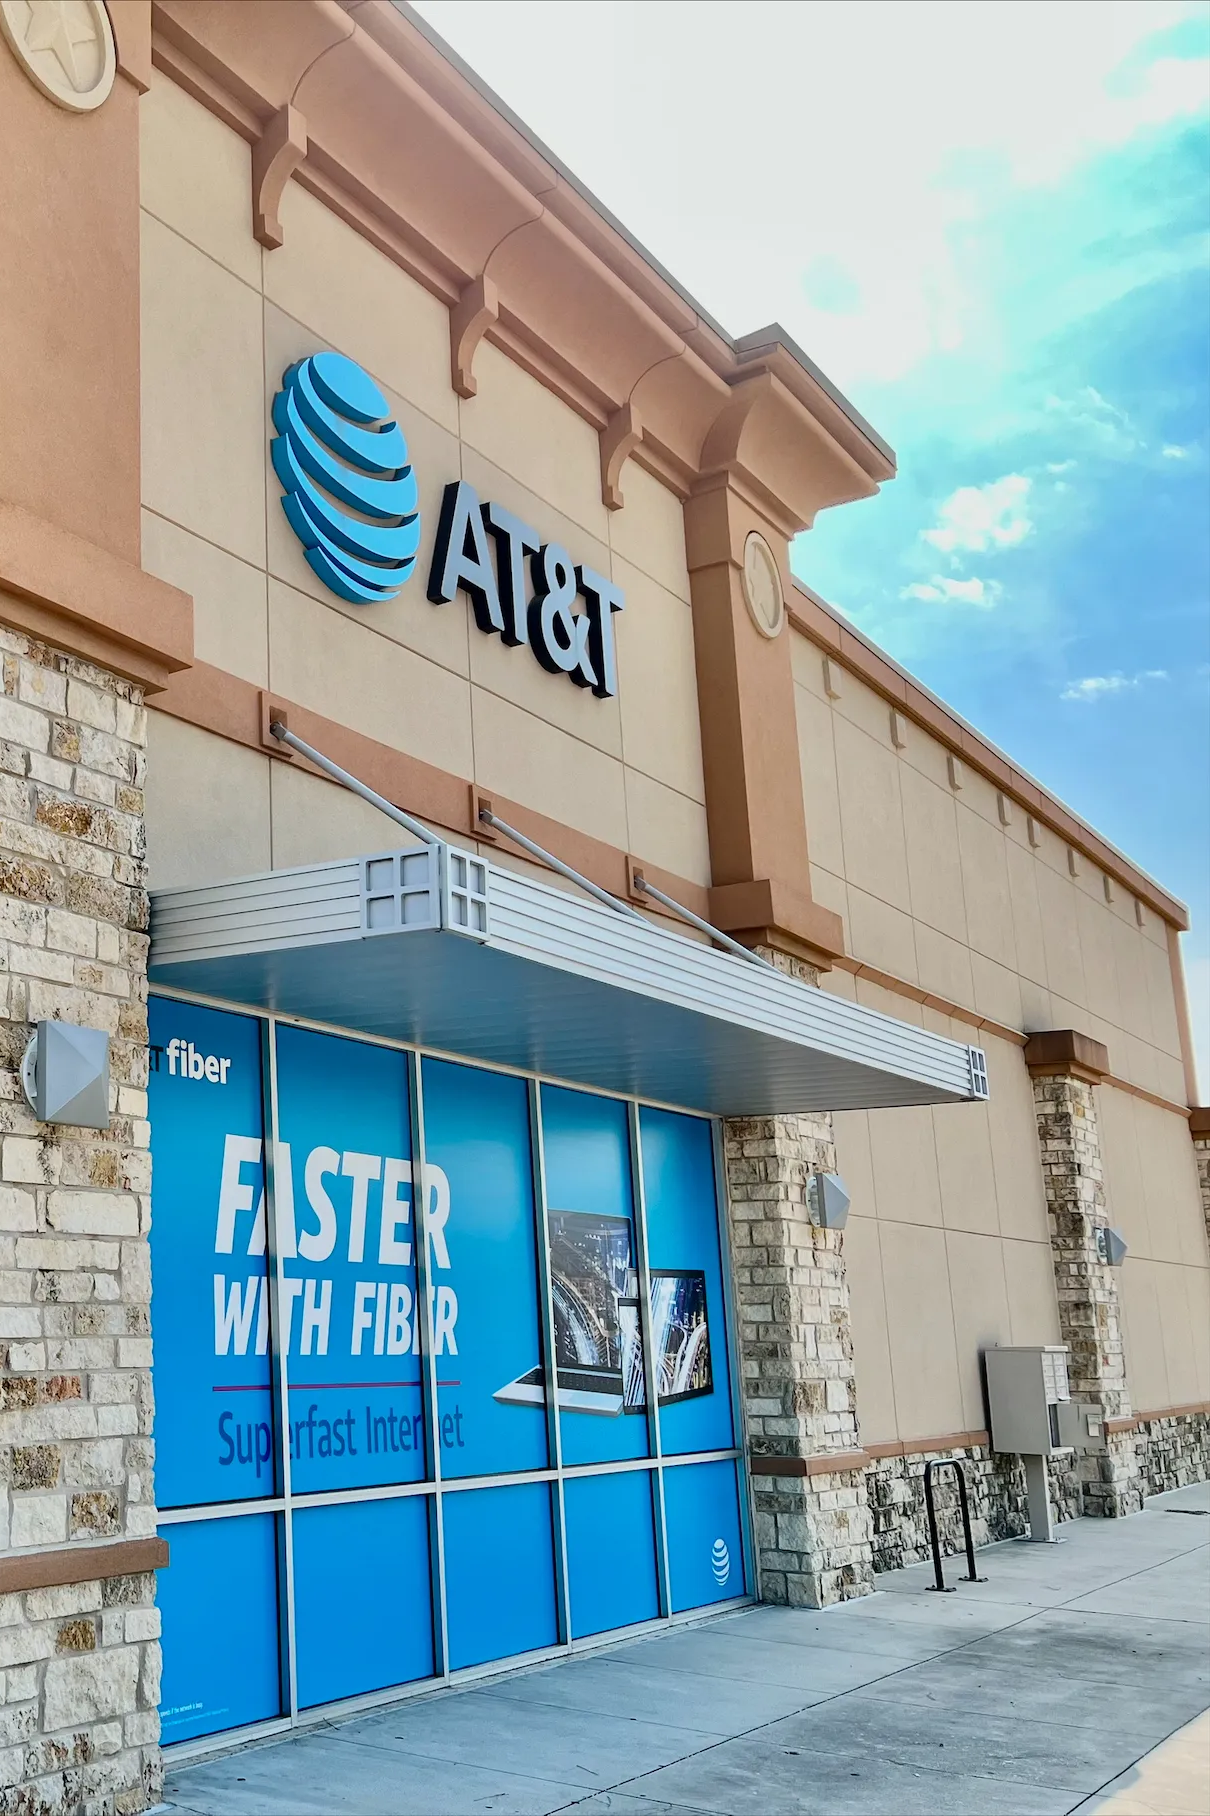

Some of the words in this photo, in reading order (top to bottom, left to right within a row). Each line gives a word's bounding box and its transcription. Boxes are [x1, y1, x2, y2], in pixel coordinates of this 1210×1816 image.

[427, 480, 626, 699] AT&T
[166, 1038, 231, 1084] fiber
[214, 1133, 452, 1270] FASTER
[213, 1273, 333, 1356] WITH
[218, 1403, 357, 1479] Suprfast
[365, 1404, 465, 1454] Interet
